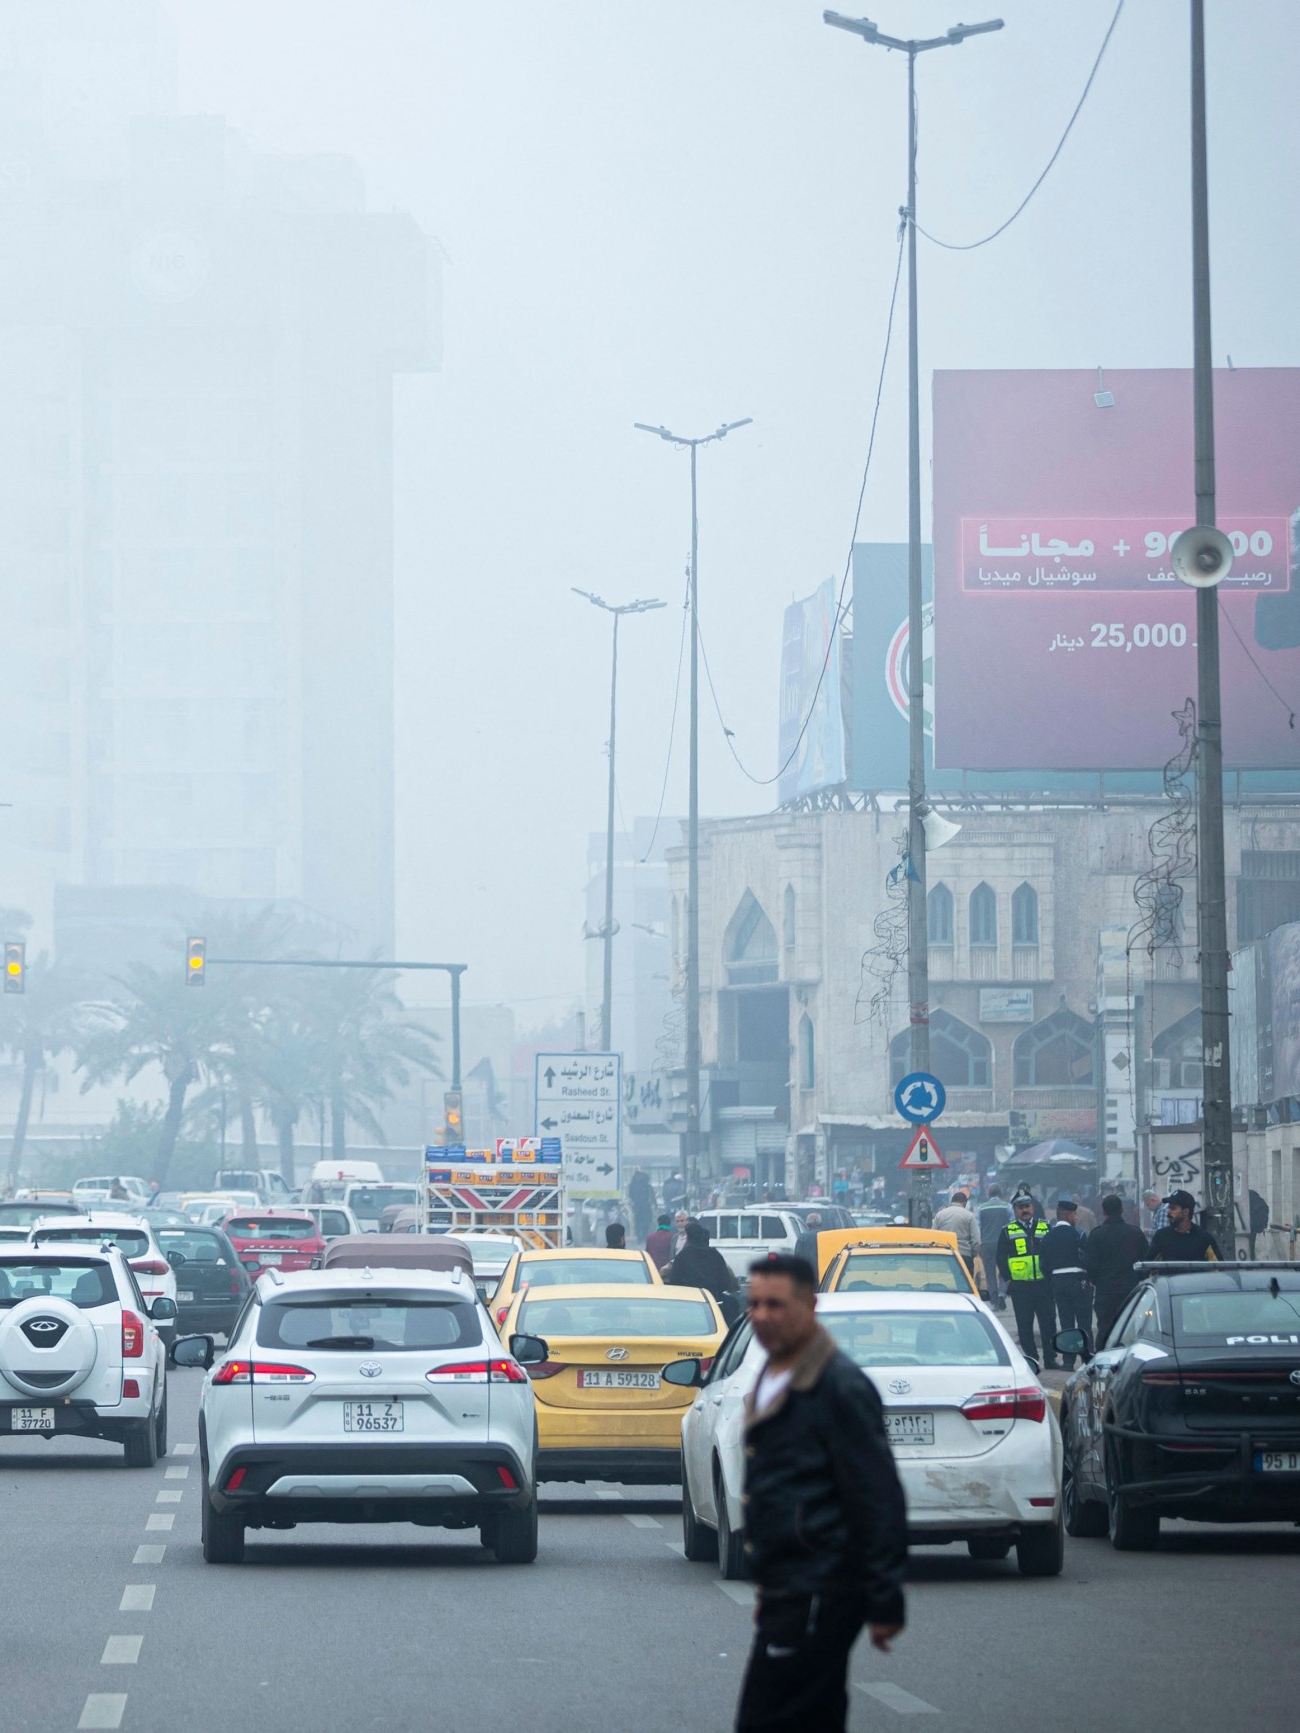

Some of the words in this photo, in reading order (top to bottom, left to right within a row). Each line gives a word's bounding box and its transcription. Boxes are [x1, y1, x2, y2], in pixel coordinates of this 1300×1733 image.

[979, 524, 1095, 563] مجاناً
[978, 567, 1021, 586] ميديا
[1028, 566, 1097, 586] سوشيال
[1224, 570, 1272, 586] رصي
[1049, 633, 1085, 652] دينار
[1090, 623, 1187, 652] 25,000
[561, 1061, 591, 1080] الرشيد
[594, 1061, 614, 1081] شارع
[561, 1086, 598, 1097] Rasheed
[599, 1087, 611, 1097] St.
[596, 1106, 613, 1125] شارع
[564, 1133, 597, 1143] Saadoun
[599, 1133, 609, 1143] St.
[574, 1152, 595, 1165] ساحة
[576, 1172, 590, 1183] Sq.
[585, 1372, 600, 1386] 11
[605, 1373, 613, 1386] A
[617, 1373, 656, 1388] 59128
[21, 1409, 33, 1418] 11
[41, 1409, 47, 1418] F
[357, 1404, 373, 1417] 11
[385, 1404, 393, 1417] Z
[21, 1419, 51, 1429] 37720
[356, 1417, 398, 1430] 96537
[1265, 1453, 1283, 1469] 95
[1288, 1454, 1297, 1469] D
